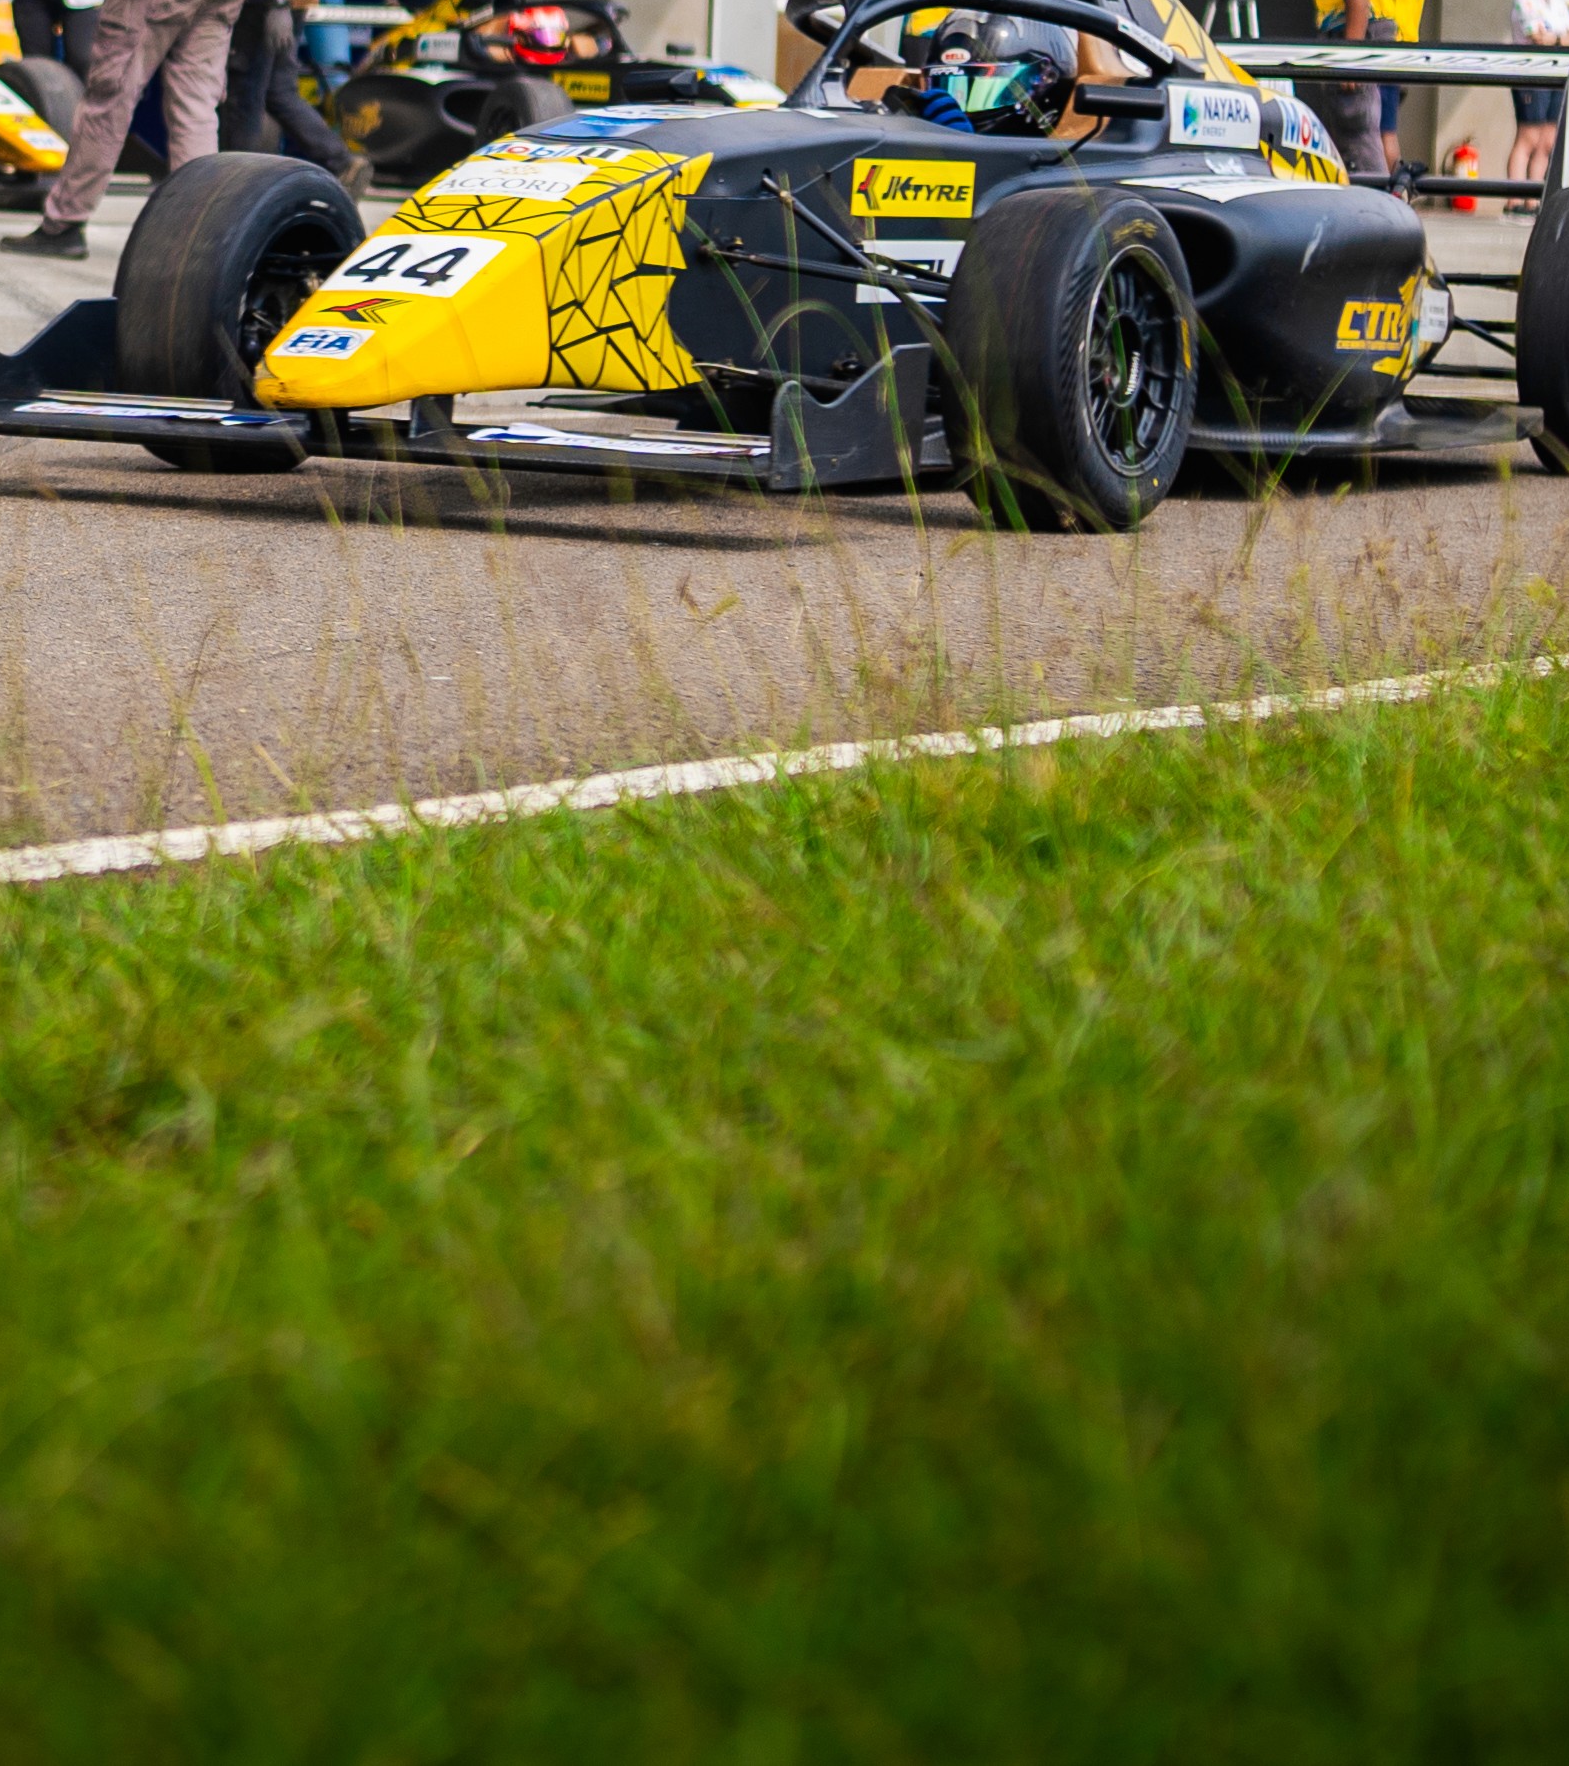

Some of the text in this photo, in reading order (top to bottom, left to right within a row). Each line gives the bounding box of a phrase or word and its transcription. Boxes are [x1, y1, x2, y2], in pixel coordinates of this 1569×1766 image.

[944, 52, 965, 61] BELL
[1203, 96, 1251, 123] NAYARA
[1202, 125, 1226, 138] ENERGY
[481, 142, 578, 159] Mobil
[438, 176, 571, 194] ACCORD
[344, 243, 470, 287] 44
[1337, 301, 1402, 340] CTR
